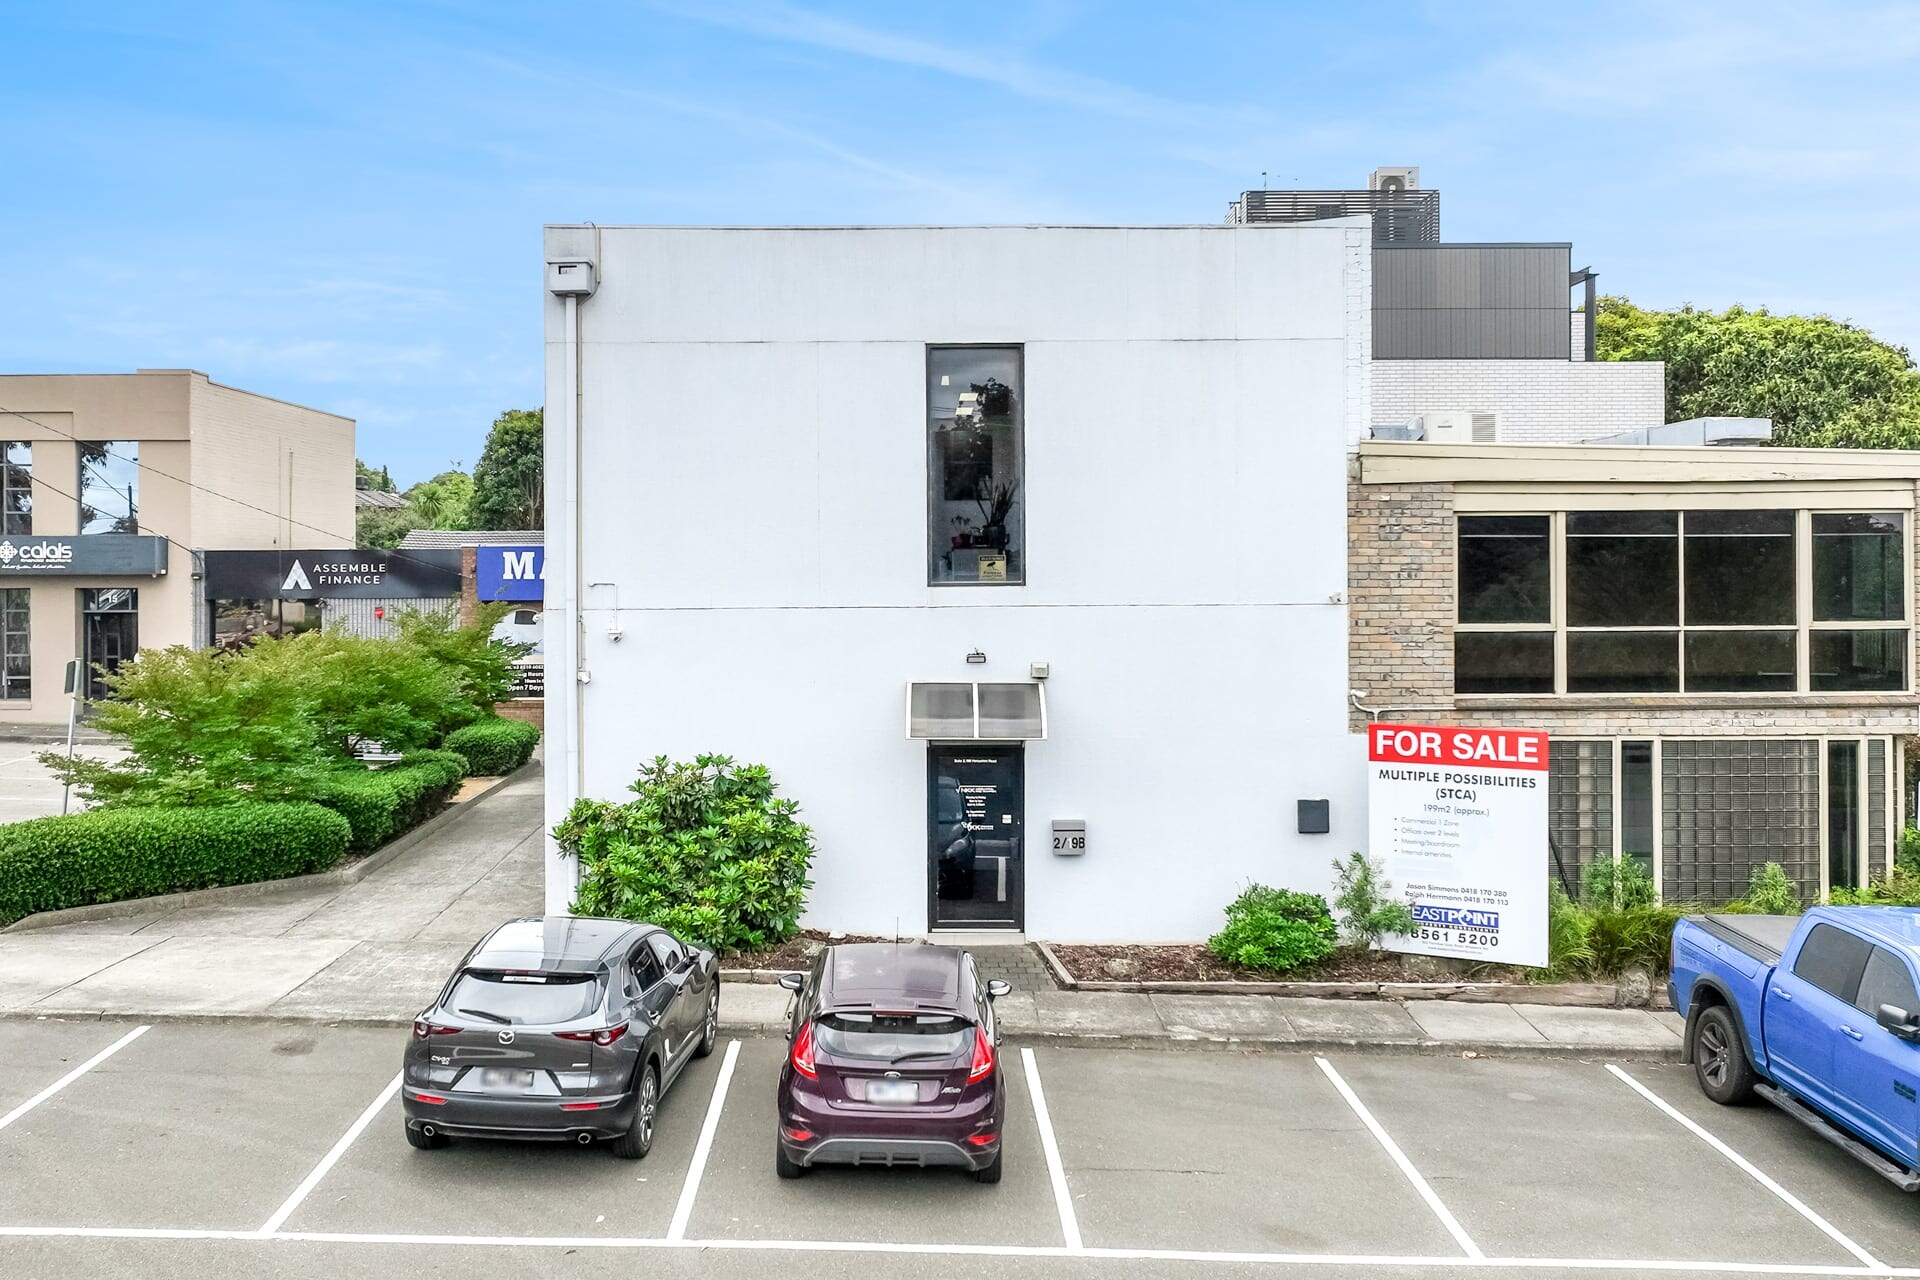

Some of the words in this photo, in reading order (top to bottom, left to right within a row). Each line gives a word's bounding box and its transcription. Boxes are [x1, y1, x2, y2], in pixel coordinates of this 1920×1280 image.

[19, 541, 73, 559] calais
[313, 563, 387, 573] ASSEMBLE
[319, 575, 381, 585] FINANCE
[1375, 729, 1443, 759] FOR
[1450, 732, 1539, 764] SALE
[1378, 768, 1440, 783] MULTIPLE
[1444, 772, 1537, 789] POSSIBILITIES
[1435, 788, 1477, 803] (STCA)
[1423, 803, 1451, 814] 199m2
[1453, 805, 1490, 817] (approx.)
[1404, 890, 1425, 899] Ralph
[1406, 882, 1426, 891] Jason
[1427, 884, 1460, 894] Simmons
[1411, 905, 1498, 926] EASTPOINT
[1410, 928, 1450, 942] 8561
[1458, 932, 1499, 947] 5200
